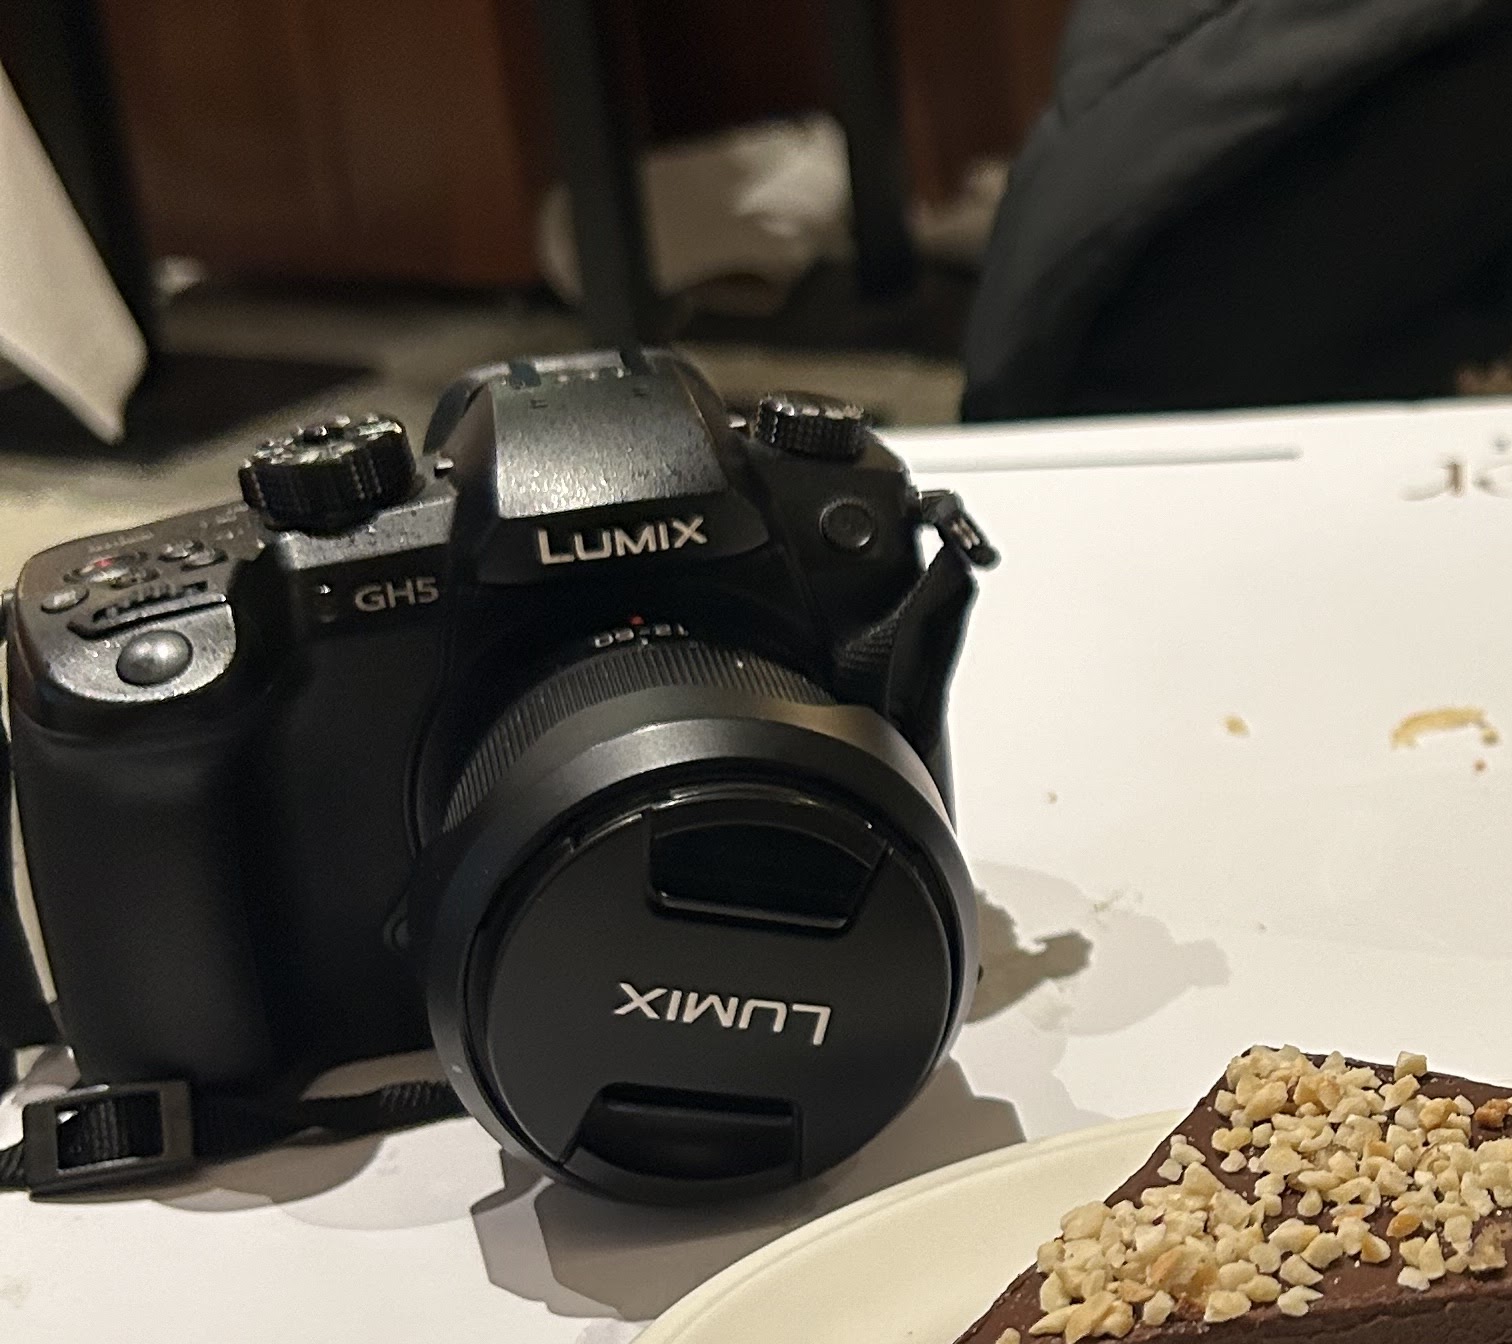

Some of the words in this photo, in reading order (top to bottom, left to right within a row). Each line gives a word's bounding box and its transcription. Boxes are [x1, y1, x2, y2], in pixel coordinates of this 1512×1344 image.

[538, 514, 709, 566] LUMIX
[354, 577, 440, 614] GH5
[614, 980, 832, 1046] LUMIX
